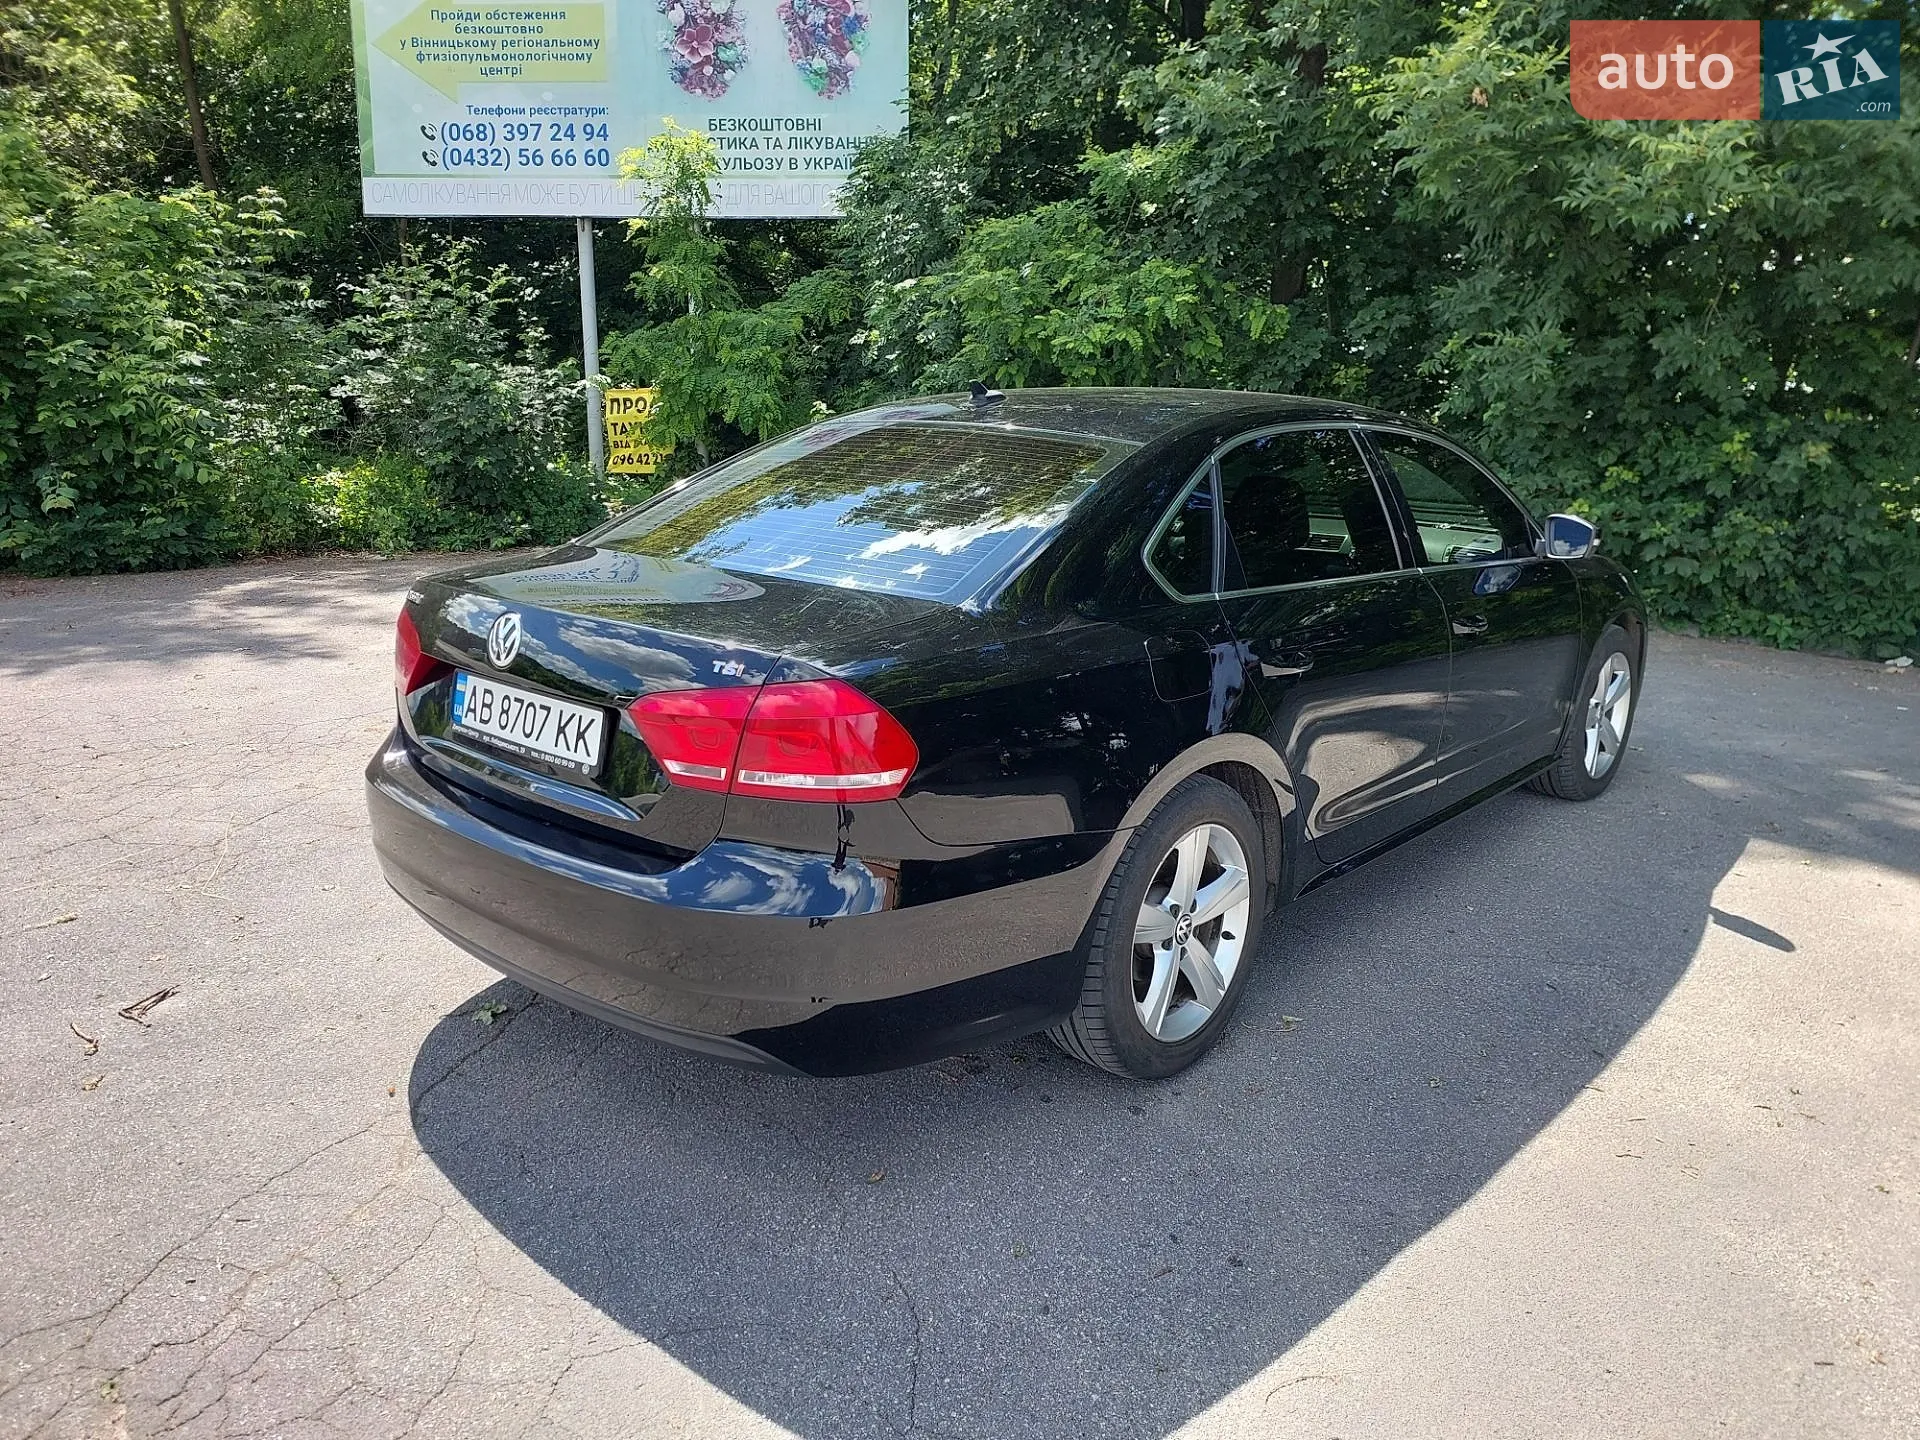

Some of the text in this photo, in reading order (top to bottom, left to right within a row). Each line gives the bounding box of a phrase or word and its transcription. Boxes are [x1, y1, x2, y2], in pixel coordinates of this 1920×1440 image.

[430, 9, 566, 22] Пройди обстеження
[454, 23, 544, 35] безкоштовно
[400, 37, 600, 50] у Вінницькому регіональному
[415, 50, 593, 64] фтизіопульмонологічному
[479, 65, 523, 78] центрі
[466, 105, 609, 119] Телефони реєстратури:
[708, 118, 822, 131] БЕЗКОШТОВНІ
[440, 122, 609, 146] (068) 397 24 94
[763, 137, 783, 150] ТА
[787, 137, 870, 151] ЛІКУВАНН
[442, 147, 610, 171] (0432) 56 66 60
[789, 157, 799, 170] В
[371, 182, 511, 204] САМОЛІКУВАННЯ
[514, 183, 565, 205] МОЖЕ
[569, 183, 613, 207] БУТИ
[726, 183, 760, 208] ДЛЯ
[609, 396, 648, 415] ПРО
[612, 453, 634, 465] 096
[636, 453, 650, 465] 42
[712, 659, 746, 678] TSI
[464, 685, 596, 758] AB 8707 KK
